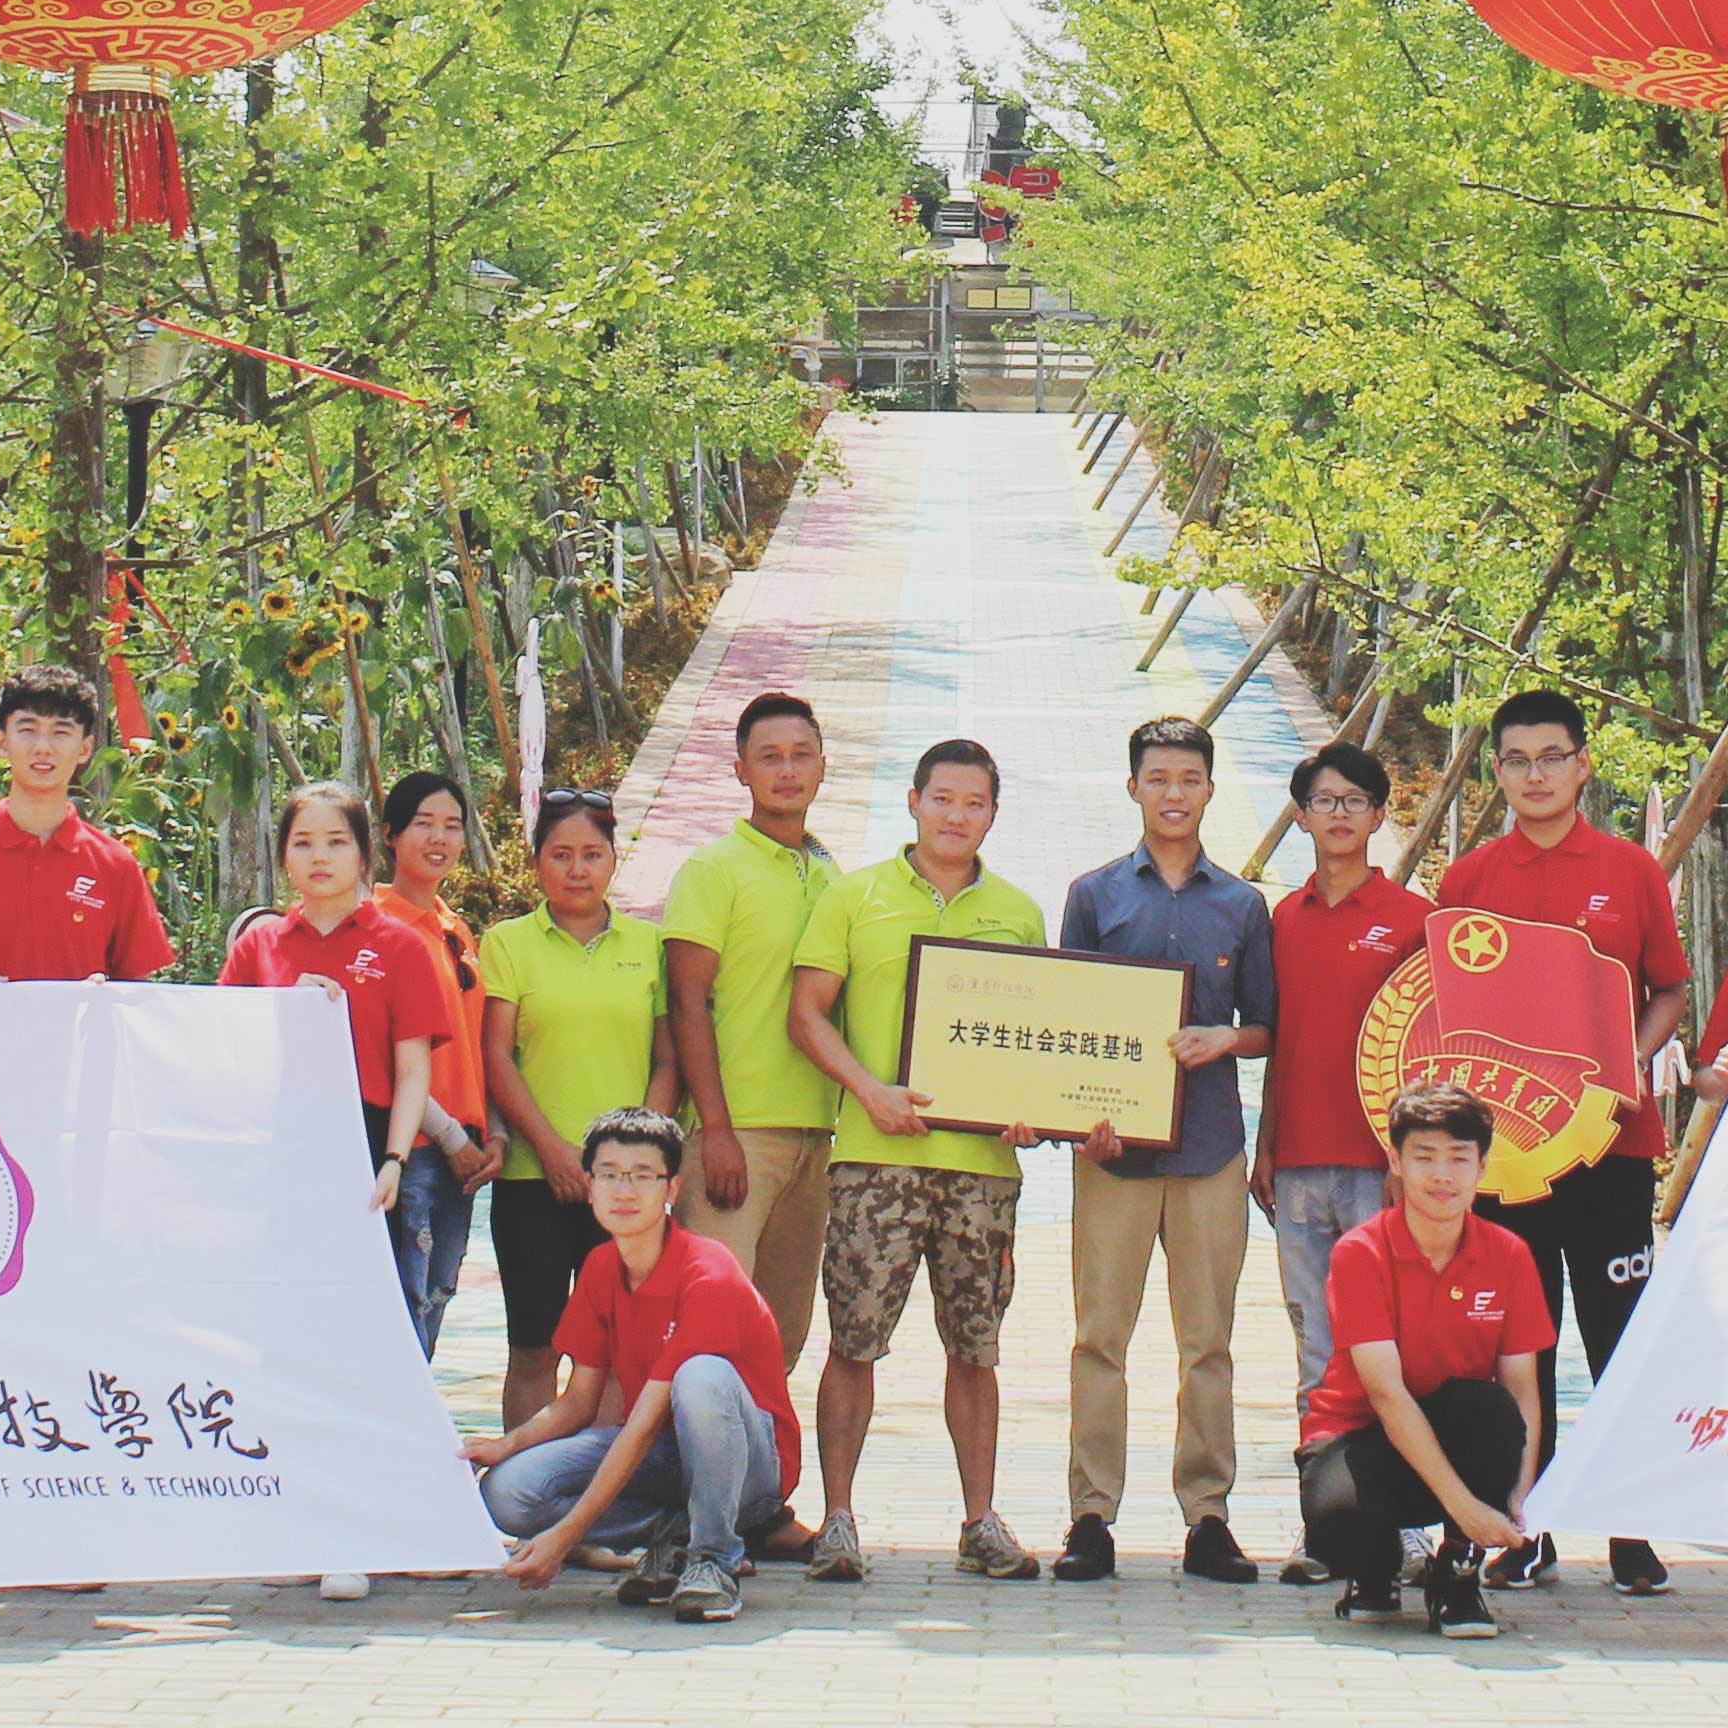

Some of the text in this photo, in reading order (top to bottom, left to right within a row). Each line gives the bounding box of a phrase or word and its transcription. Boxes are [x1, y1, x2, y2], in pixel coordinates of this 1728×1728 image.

[948, 1017, 1143, 1062] 大学生社会实践基地
[1607, 1244, 1653, 1284] ad
[23, 1474, 111, 1499] SCIENCE
[122, 1475, 136, 1497] &
[144, 1474, 284, 1499] TECHNOLOGY
